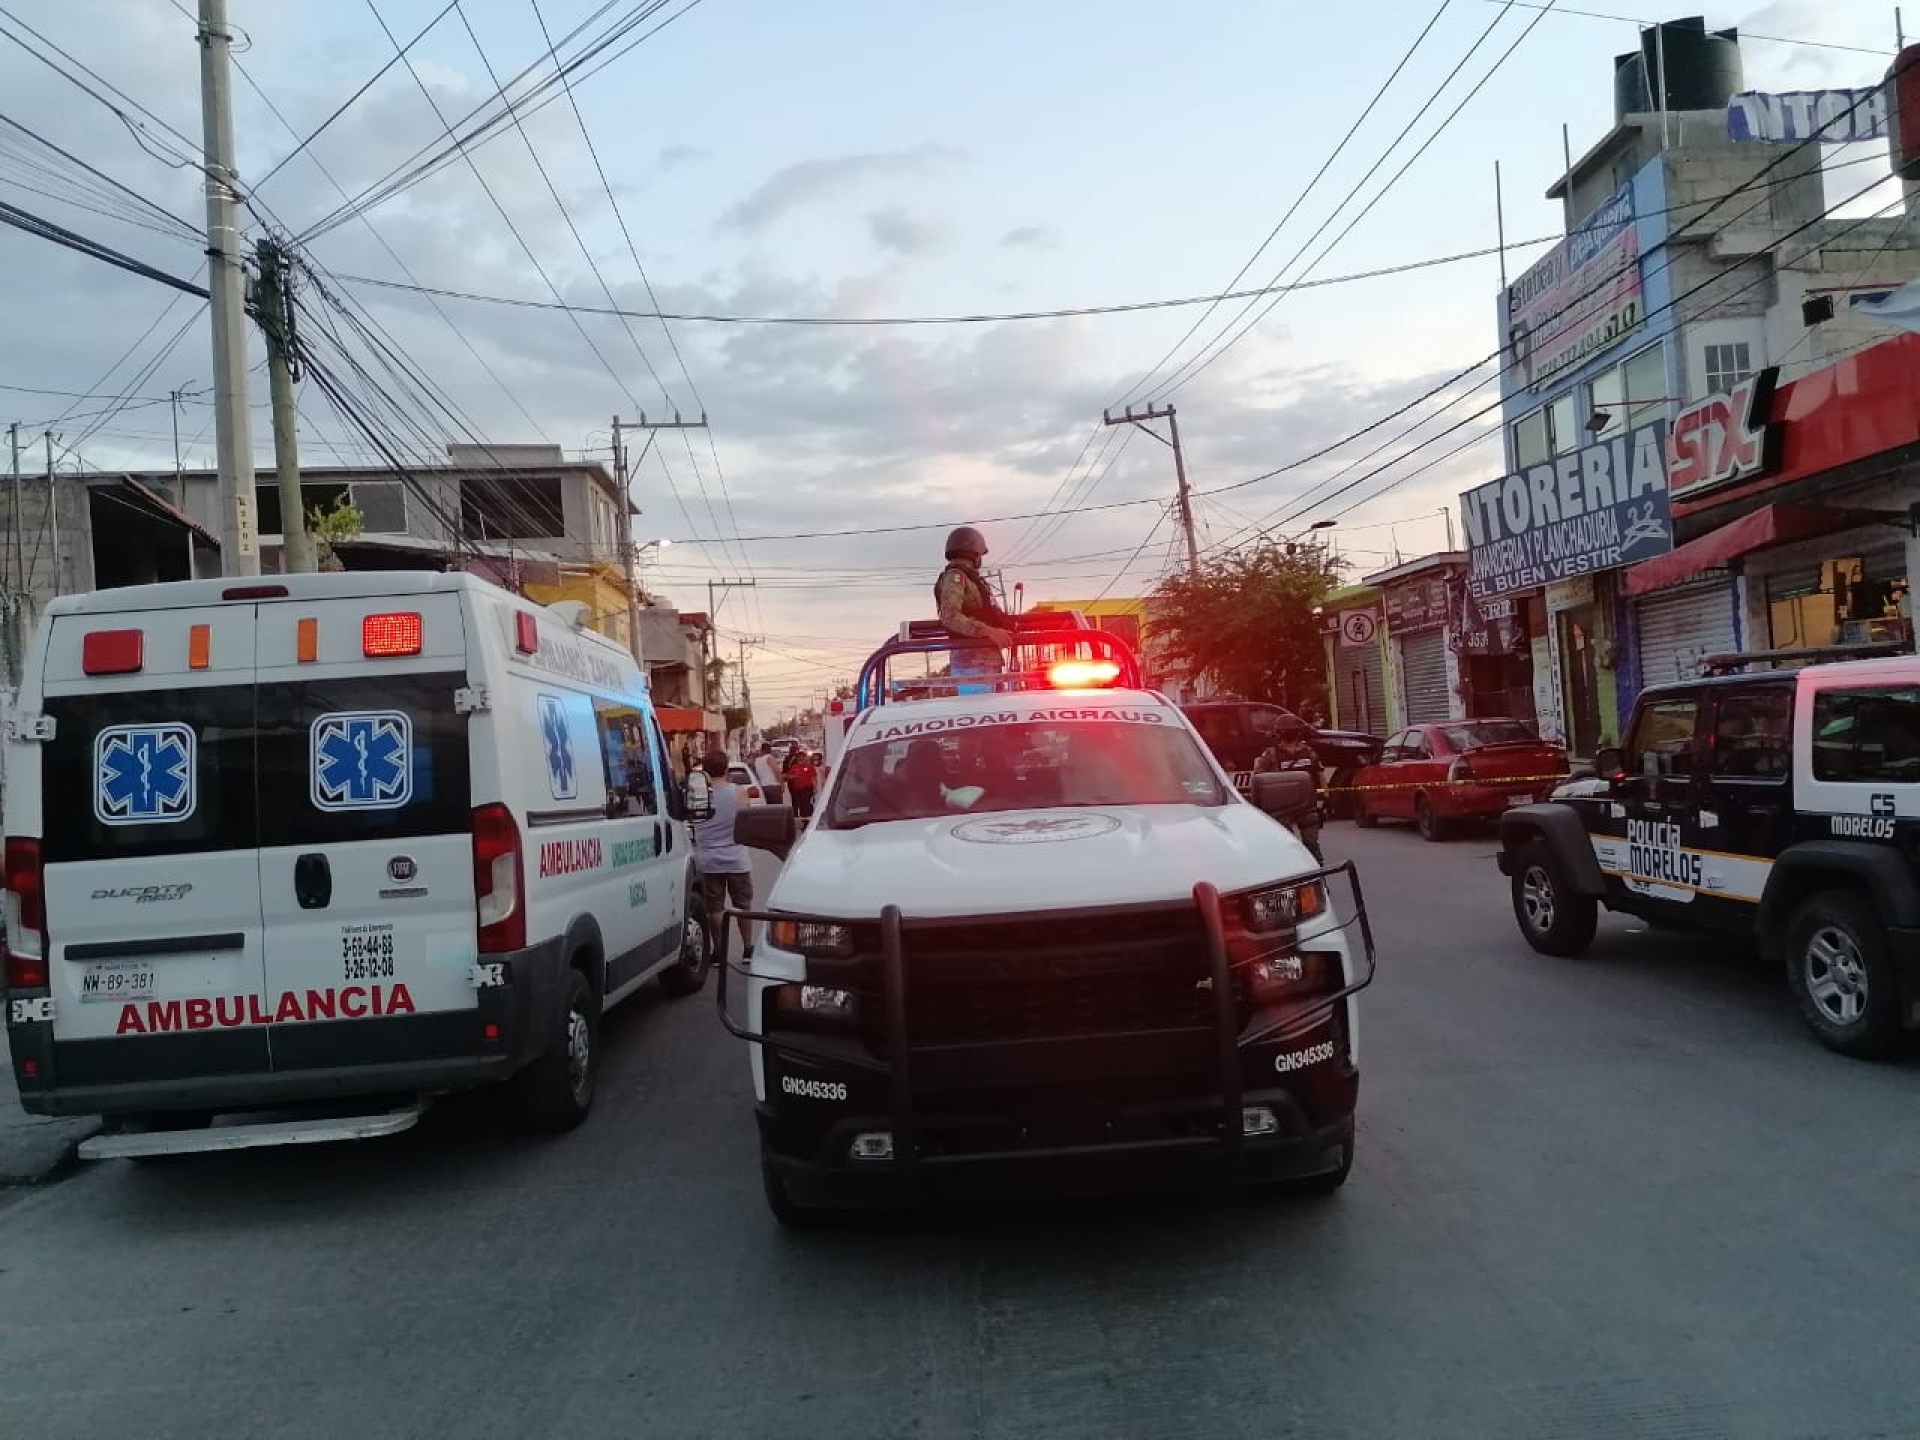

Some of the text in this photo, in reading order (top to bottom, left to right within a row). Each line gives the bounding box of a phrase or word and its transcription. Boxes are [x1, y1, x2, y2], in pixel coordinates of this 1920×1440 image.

[1668, 376, 1765, 497] SIX
[1472, 546, 1623, 598] EL BUEN VESTIR
[1831, 816, 1896, 838] MORELOS
[540, 837, 602, 879] AMBULANCIA
[1630, 845, 1702, 886] MORELOS
[91, 883, 192, 899] DUCATO
[116, 983, 416, 1034] AMBULANCIA
[1275, 1040, 1333, 1071] GN345336
[782, 1075, 846, 1100] GN345336
